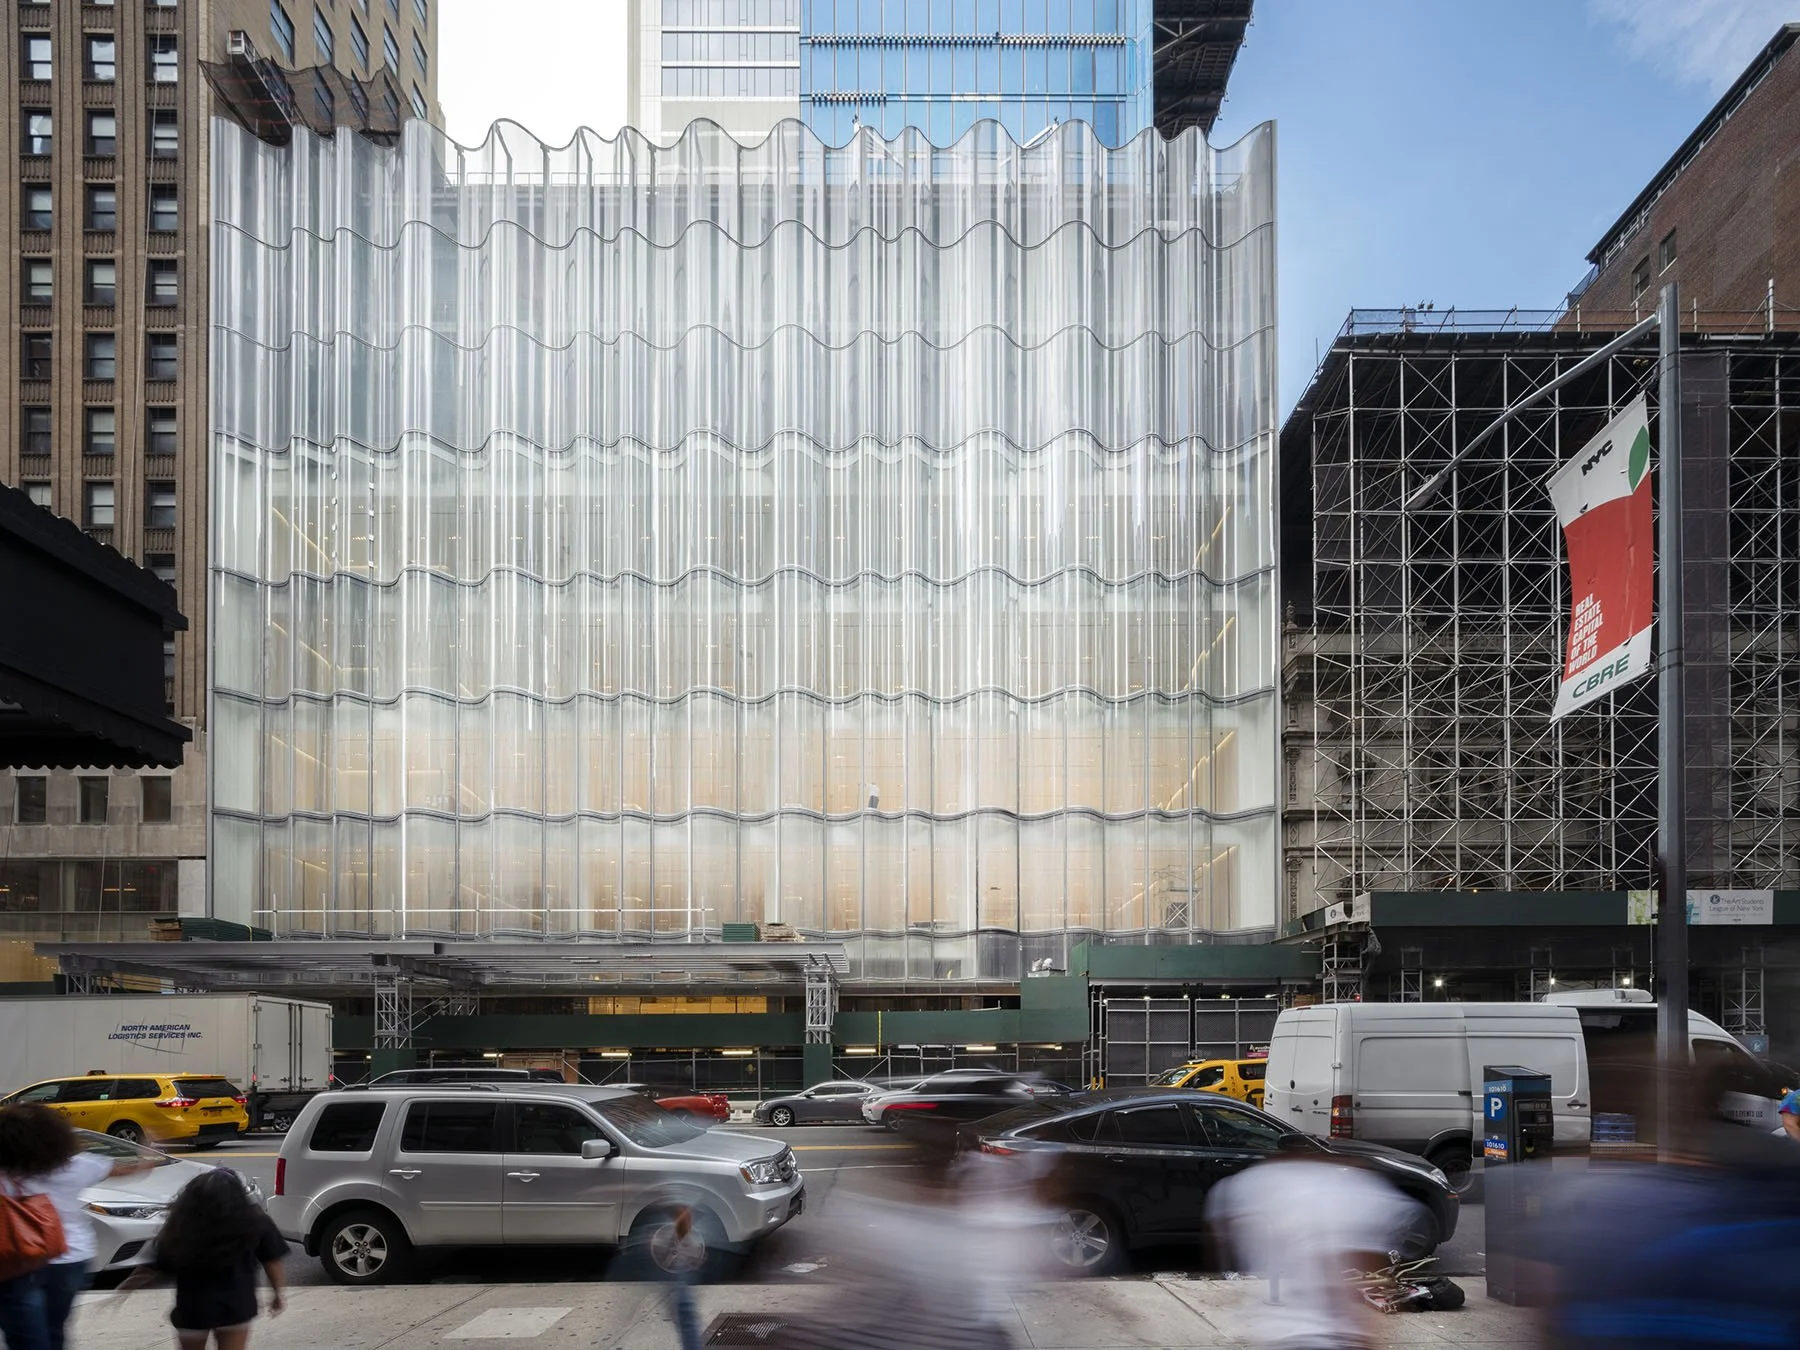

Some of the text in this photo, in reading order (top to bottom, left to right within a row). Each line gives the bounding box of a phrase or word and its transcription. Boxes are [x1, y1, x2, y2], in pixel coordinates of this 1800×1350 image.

[1581, 439, 1613, 476] NYC
[1574, 600, 1601, 632] ESTATE
[1575, 593, 1594, 618] REAL
[1572, 613, 1604, 646] CAPITAL
[1568, 644, 1598, 674] WORLD
[1571, 631, 1598, 660] OF THE
[1572, 653, 1630, 698] CBRE
[1491, 1097, 1502, 1118] P
